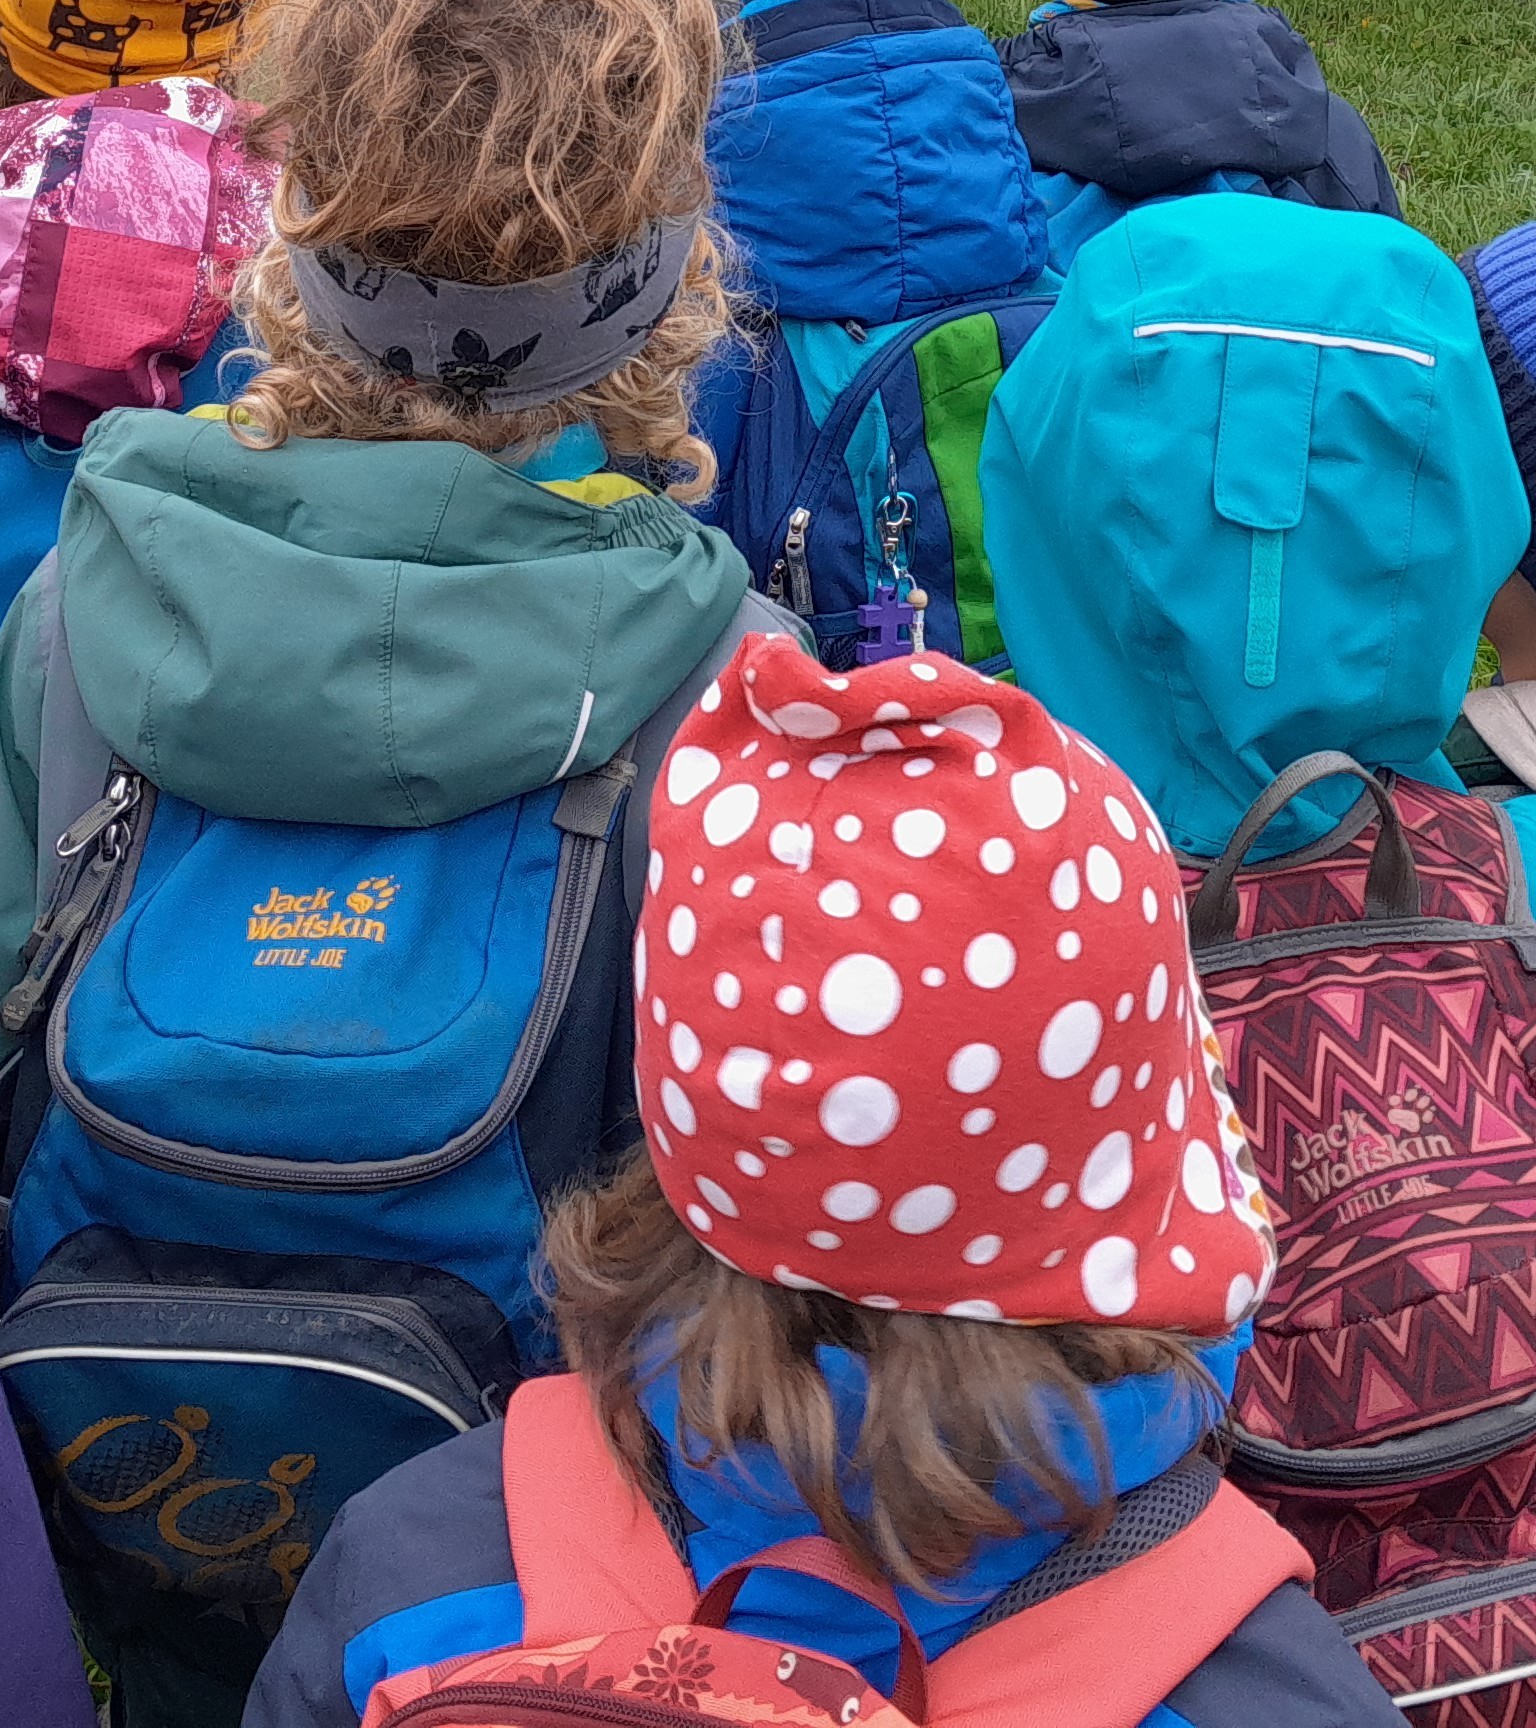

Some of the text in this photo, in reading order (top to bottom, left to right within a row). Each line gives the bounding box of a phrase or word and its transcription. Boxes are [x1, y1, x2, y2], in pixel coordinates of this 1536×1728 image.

[252, 886, 336, 915] Jack
[245, 912, 387, 943] Wolfskin
[252, 948, 348, 969] LITTLE JOE
[1290, 1109, 1367, 1171] Jack
[1294, 1133, 1455, 1205] Wolfskin
[1336, 1183, 1394, 1225] LITTLE
